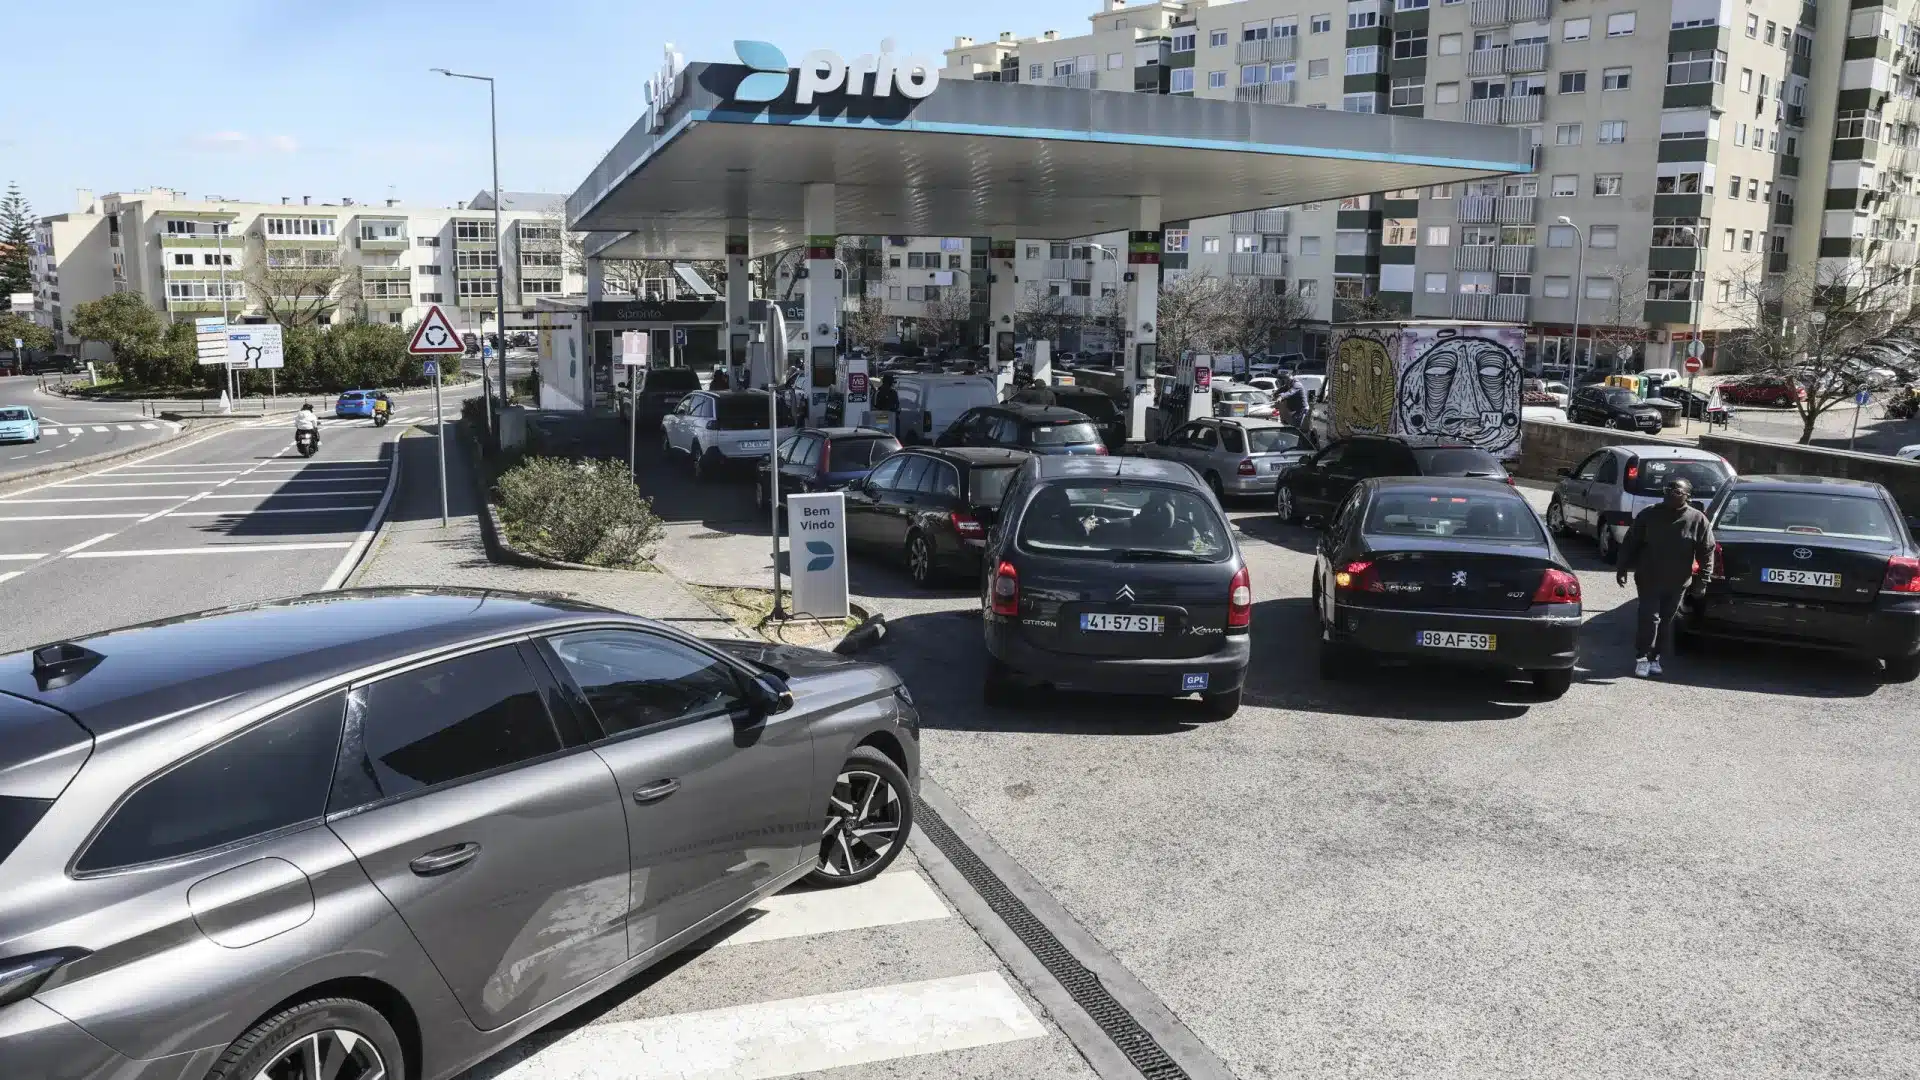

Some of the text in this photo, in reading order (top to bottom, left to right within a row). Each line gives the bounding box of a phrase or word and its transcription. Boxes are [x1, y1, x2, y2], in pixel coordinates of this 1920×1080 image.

[796, 36, 939, 104] prio
[1484, 414, 1498, 425] Ai!
[803, 508, 830, 517] Bem
[800, 520, 835, 530] Vindo
[1187, 676, 1205, 684] GPL
